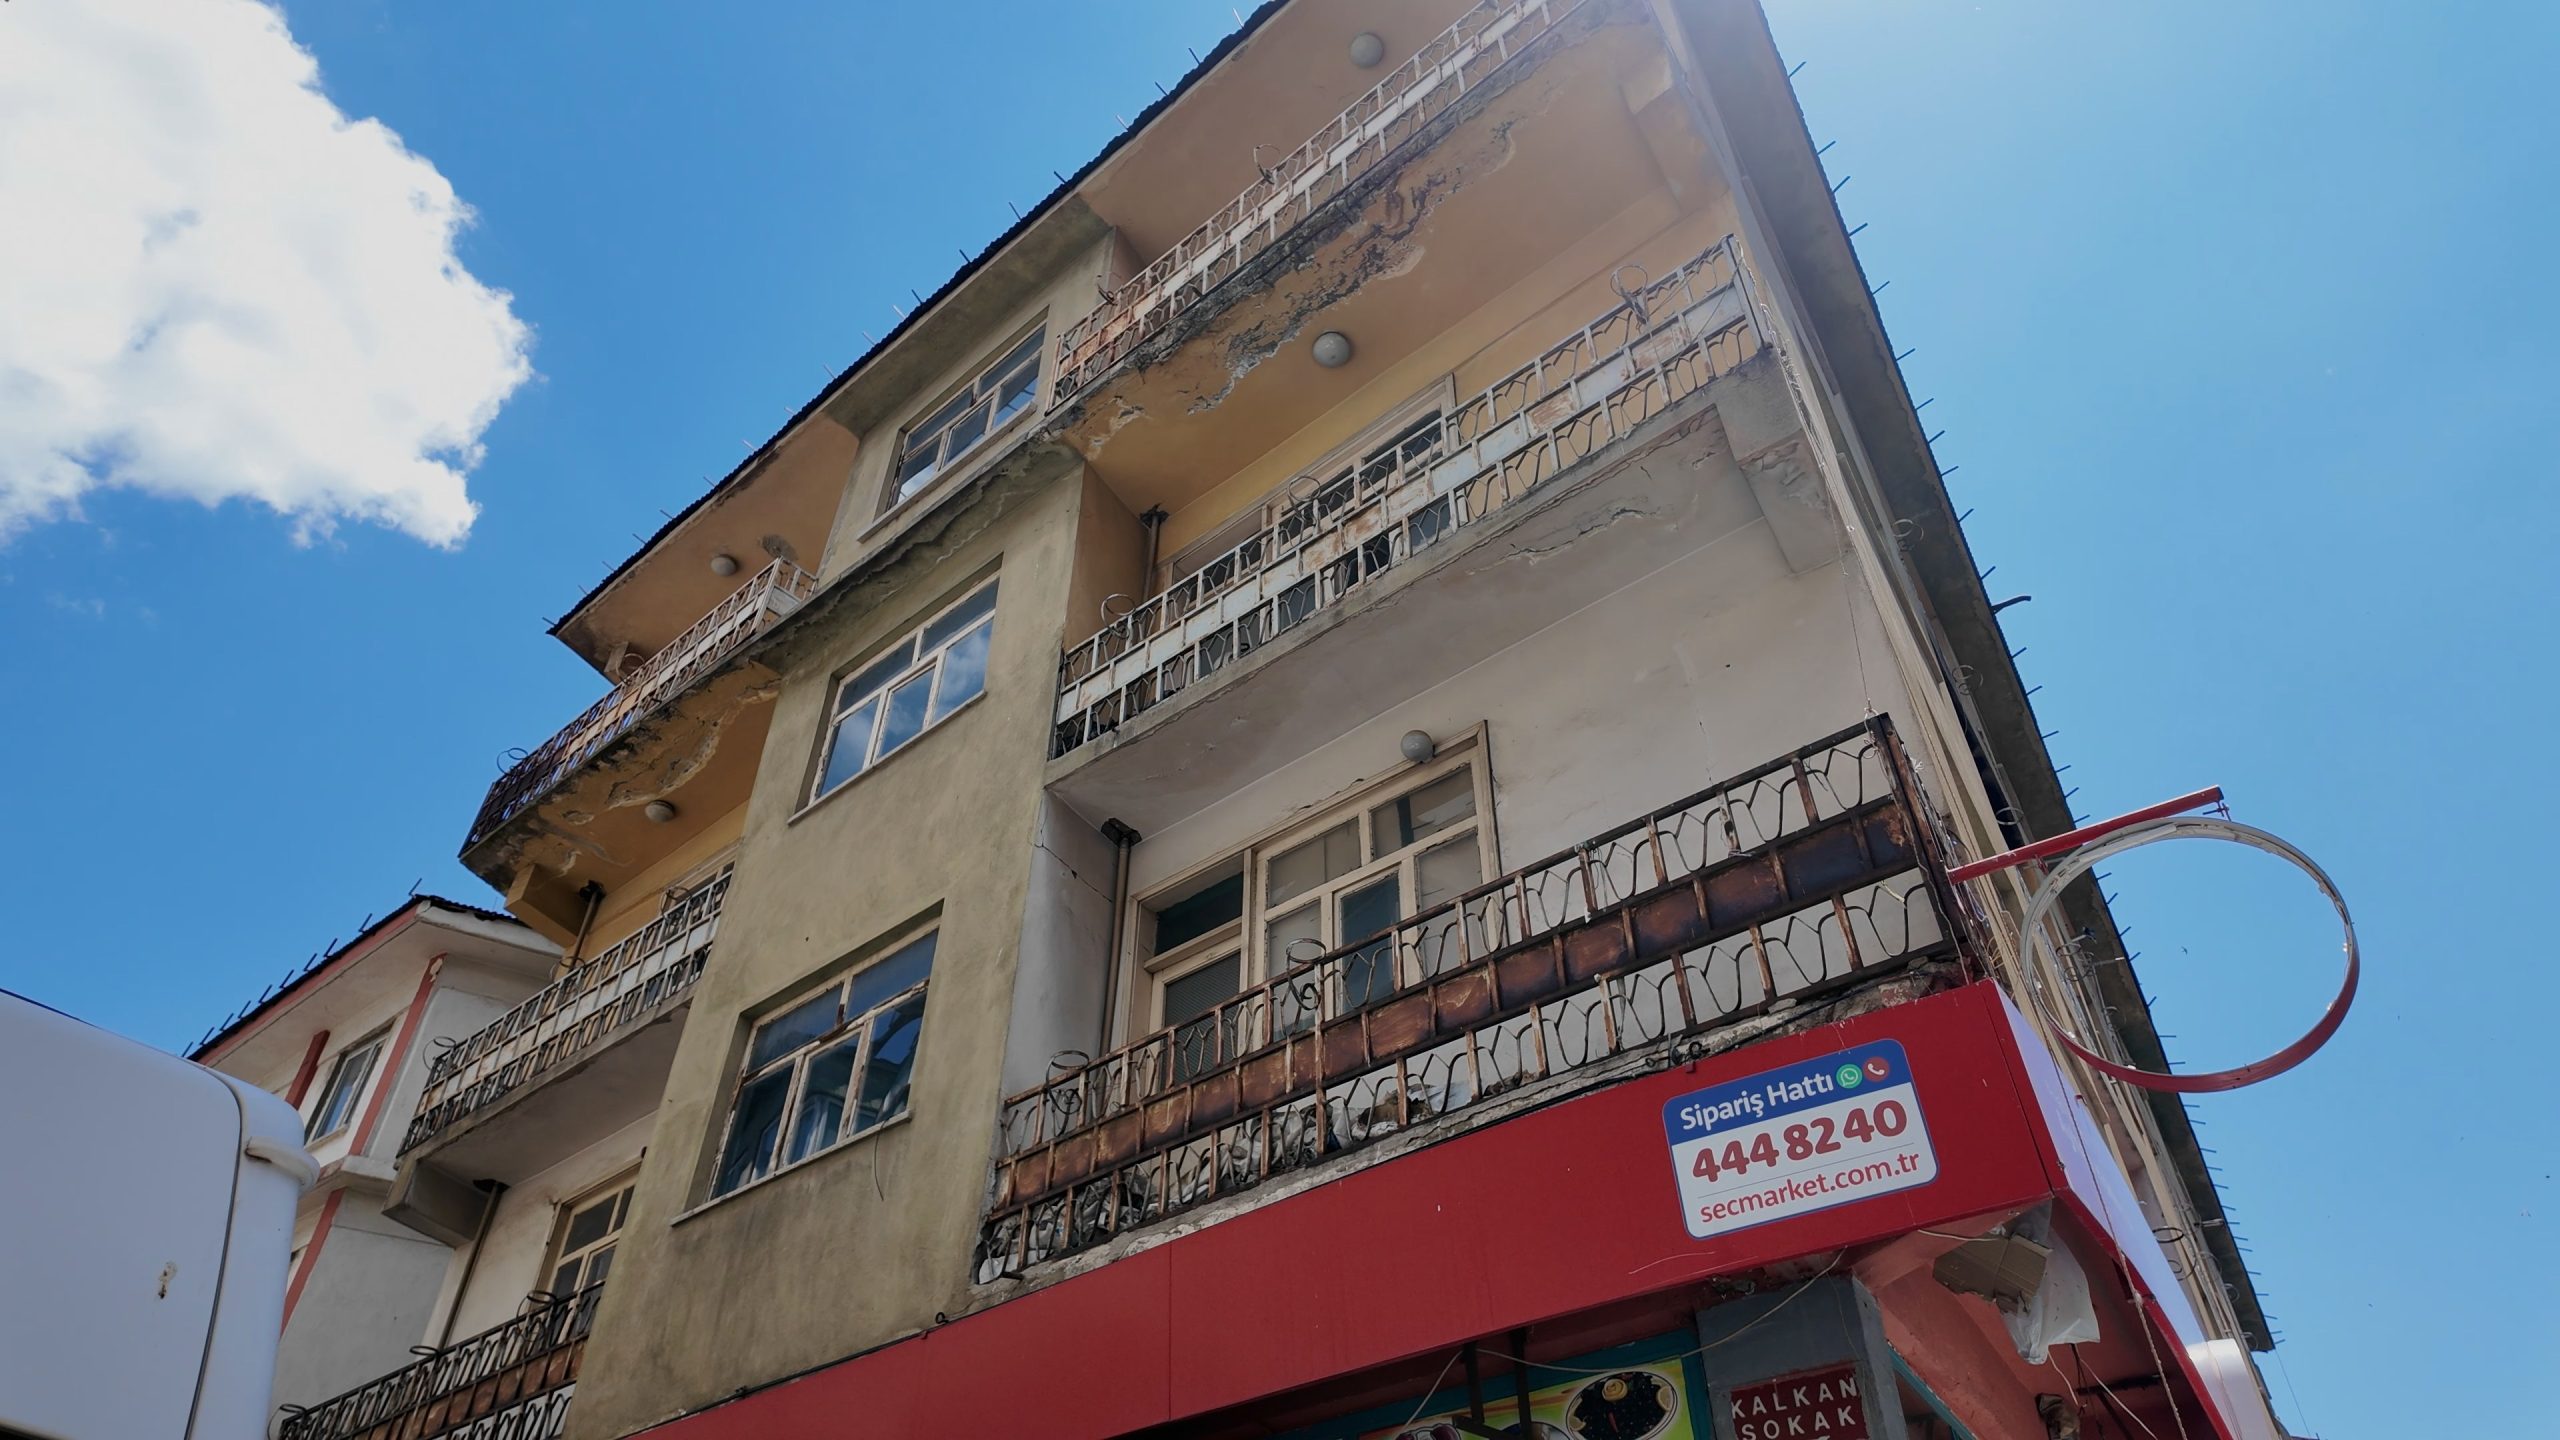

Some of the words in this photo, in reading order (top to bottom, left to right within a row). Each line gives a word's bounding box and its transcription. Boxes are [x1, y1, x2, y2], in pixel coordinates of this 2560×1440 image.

[1680, 1091, 1765, 1131] Sipariş
[1767, 1072, 1834, 1107] Hattı
[1700, 1152, 1920, 1223] secmarket.com.tr
[1731, 1377, 1858, 1419] KALKAN
[1741, 1405, 1856, 1440] SOKAK
